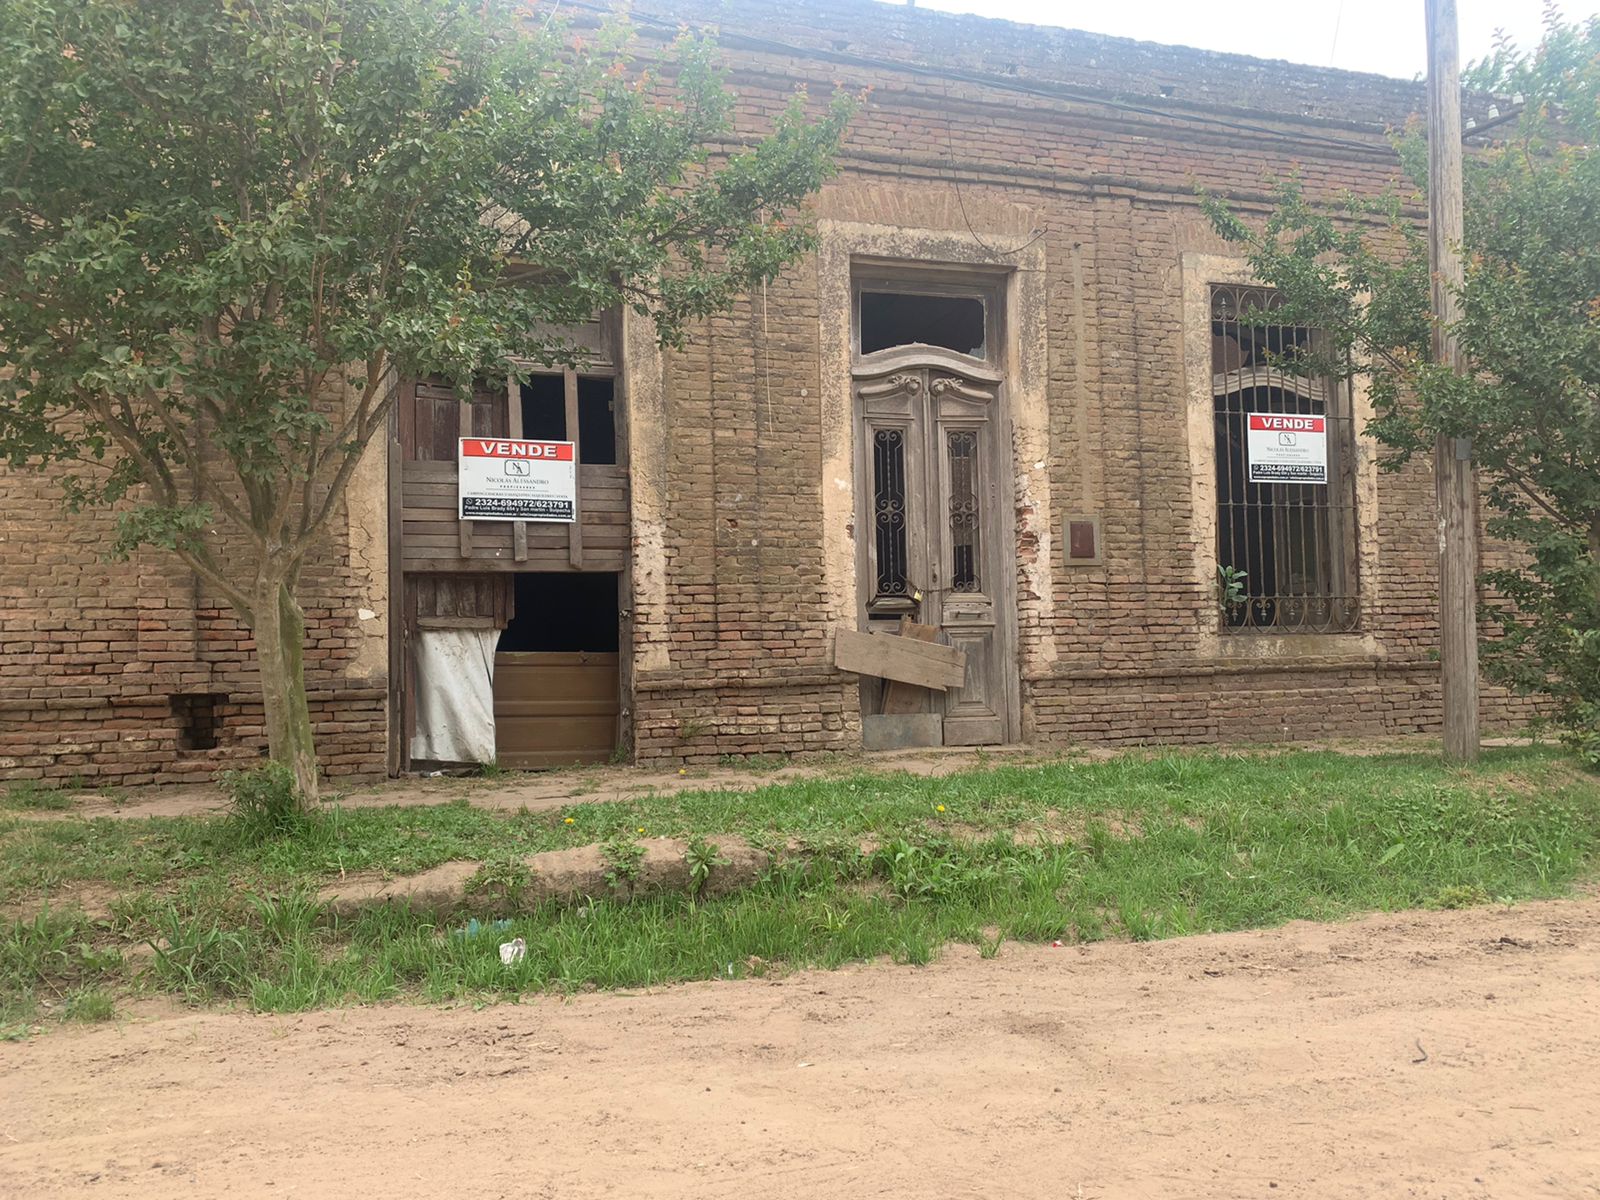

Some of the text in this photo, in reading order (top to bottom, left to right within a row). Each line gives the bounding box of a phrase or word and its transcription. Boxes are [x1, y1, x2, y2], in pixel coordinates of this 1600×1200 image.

[1262, 417, 1314, 430] VENDE
[479, 441, 558, 458] VENDE
[475, 498, 569, 509] 2324-694972/623791
